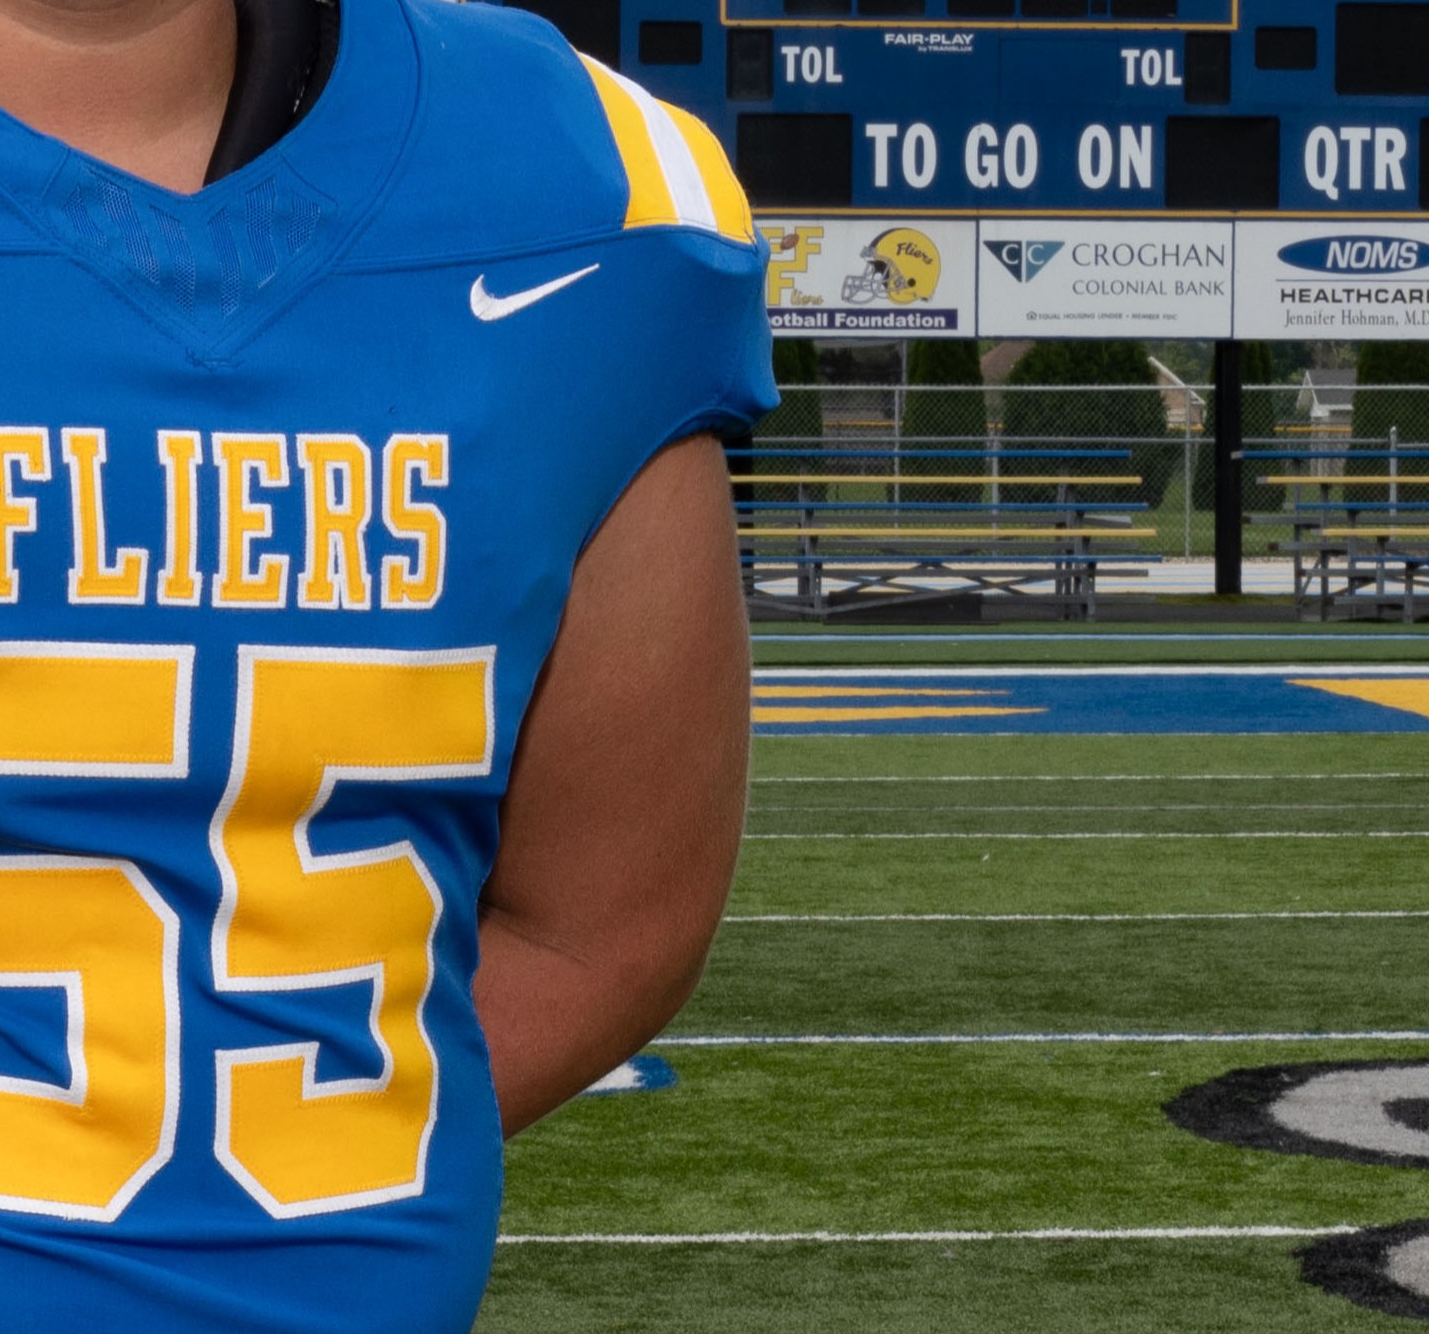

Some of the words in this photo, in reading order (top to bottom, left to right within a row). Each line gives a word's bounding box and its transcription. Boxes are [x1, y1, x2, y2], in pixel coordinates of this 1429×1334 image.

[884, 33, 974, 45] FAIR-PLAY
[780, 45, 843, 83] TOL
[1120, 49, 1182, 86] TOL
[865, 122, 938, 189] TO
[964, 122, 1039, 190] GO
[1077, 123, 1153, 190] ON
[1304, 125, 1408, 201] QTR
[896, 241, 933, 266] Fliers
[1071, 242, 1226, 268] CROGHAN
[1325, 241, 1419, 269] NOMS
[1072, 279, 1168, 296] COLONIAL
[1174, 280, 1226, 296] BANK
[771, 312, 829, 328] otball
[834, 312, 946, 328] Foundation
[1284, 308, 1336, 328] Jennifer
[1340, 309, 1399, 327] Hohman,
